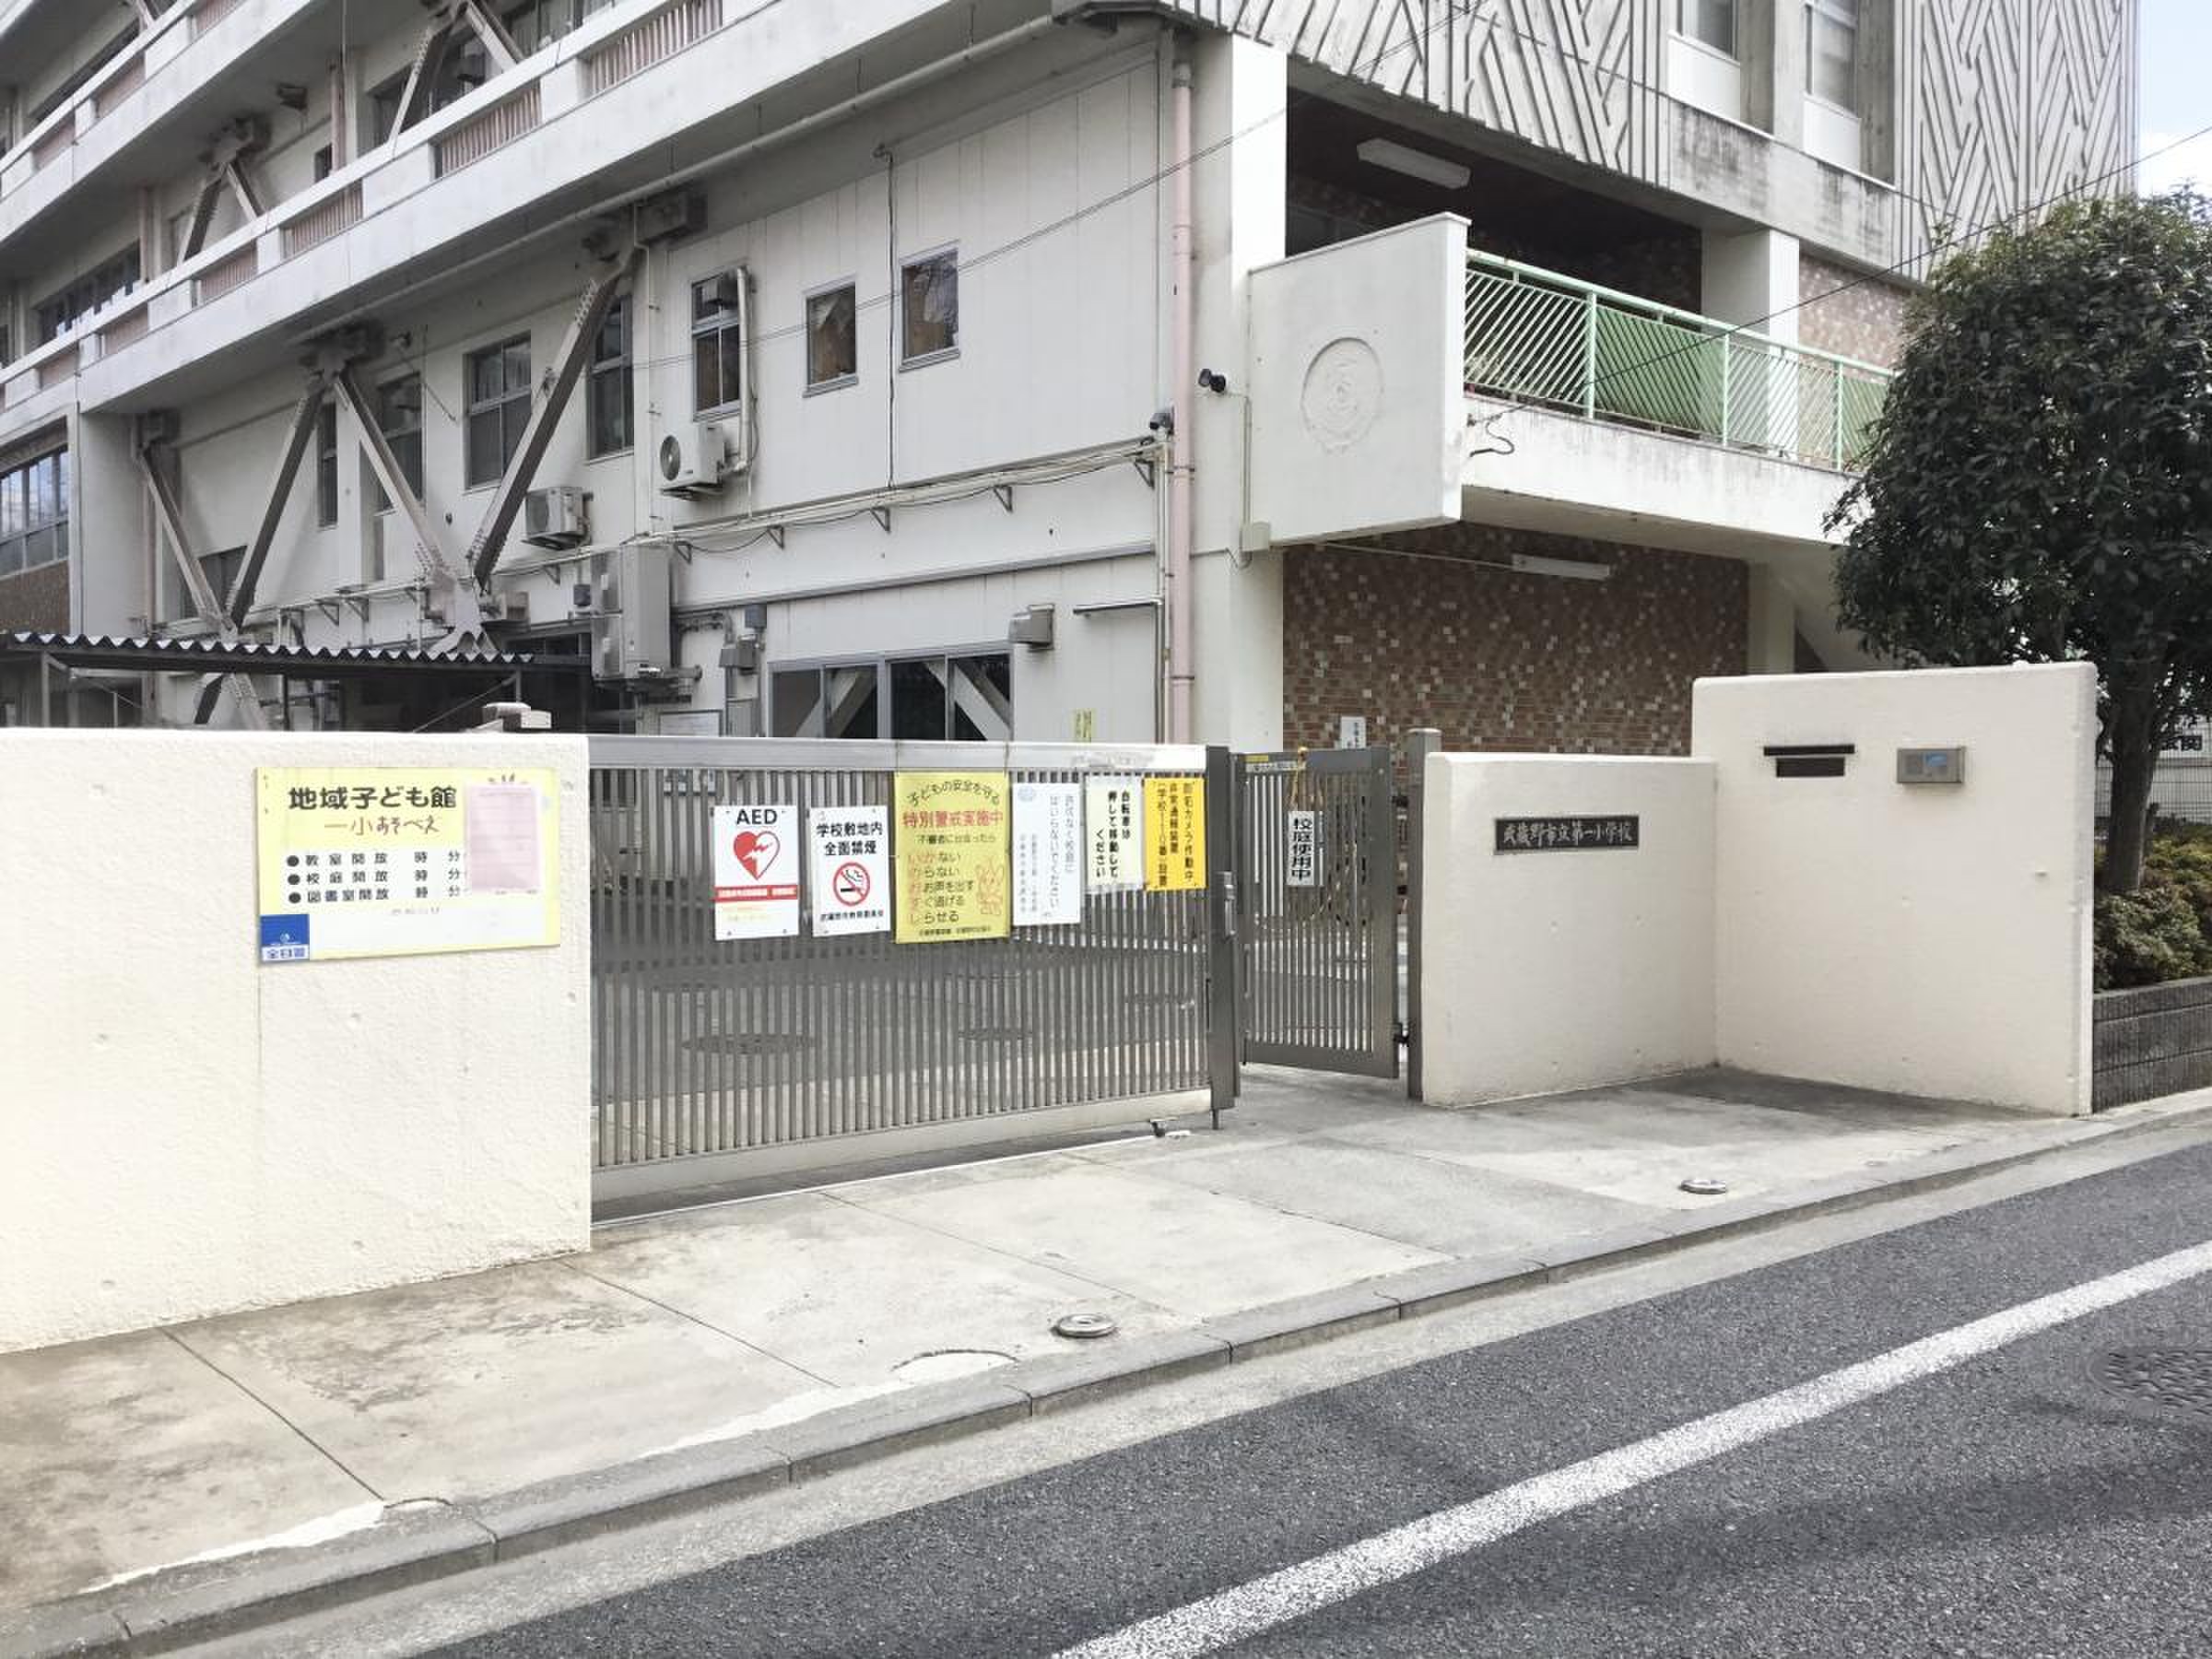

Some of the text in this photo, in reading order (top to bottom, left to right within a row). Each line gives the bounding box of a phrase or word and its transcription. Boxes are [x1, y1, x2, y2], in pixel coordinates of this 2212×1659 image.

[288, 786, 456, 810] 地域子ども館
[736, 808, 778, 826] AED
[816, 821, 883, 838] 学校敷地内
[824, 839, 877, 857] 全面禁煙
[1292, 818, 1313, 881] 校庭使用中
